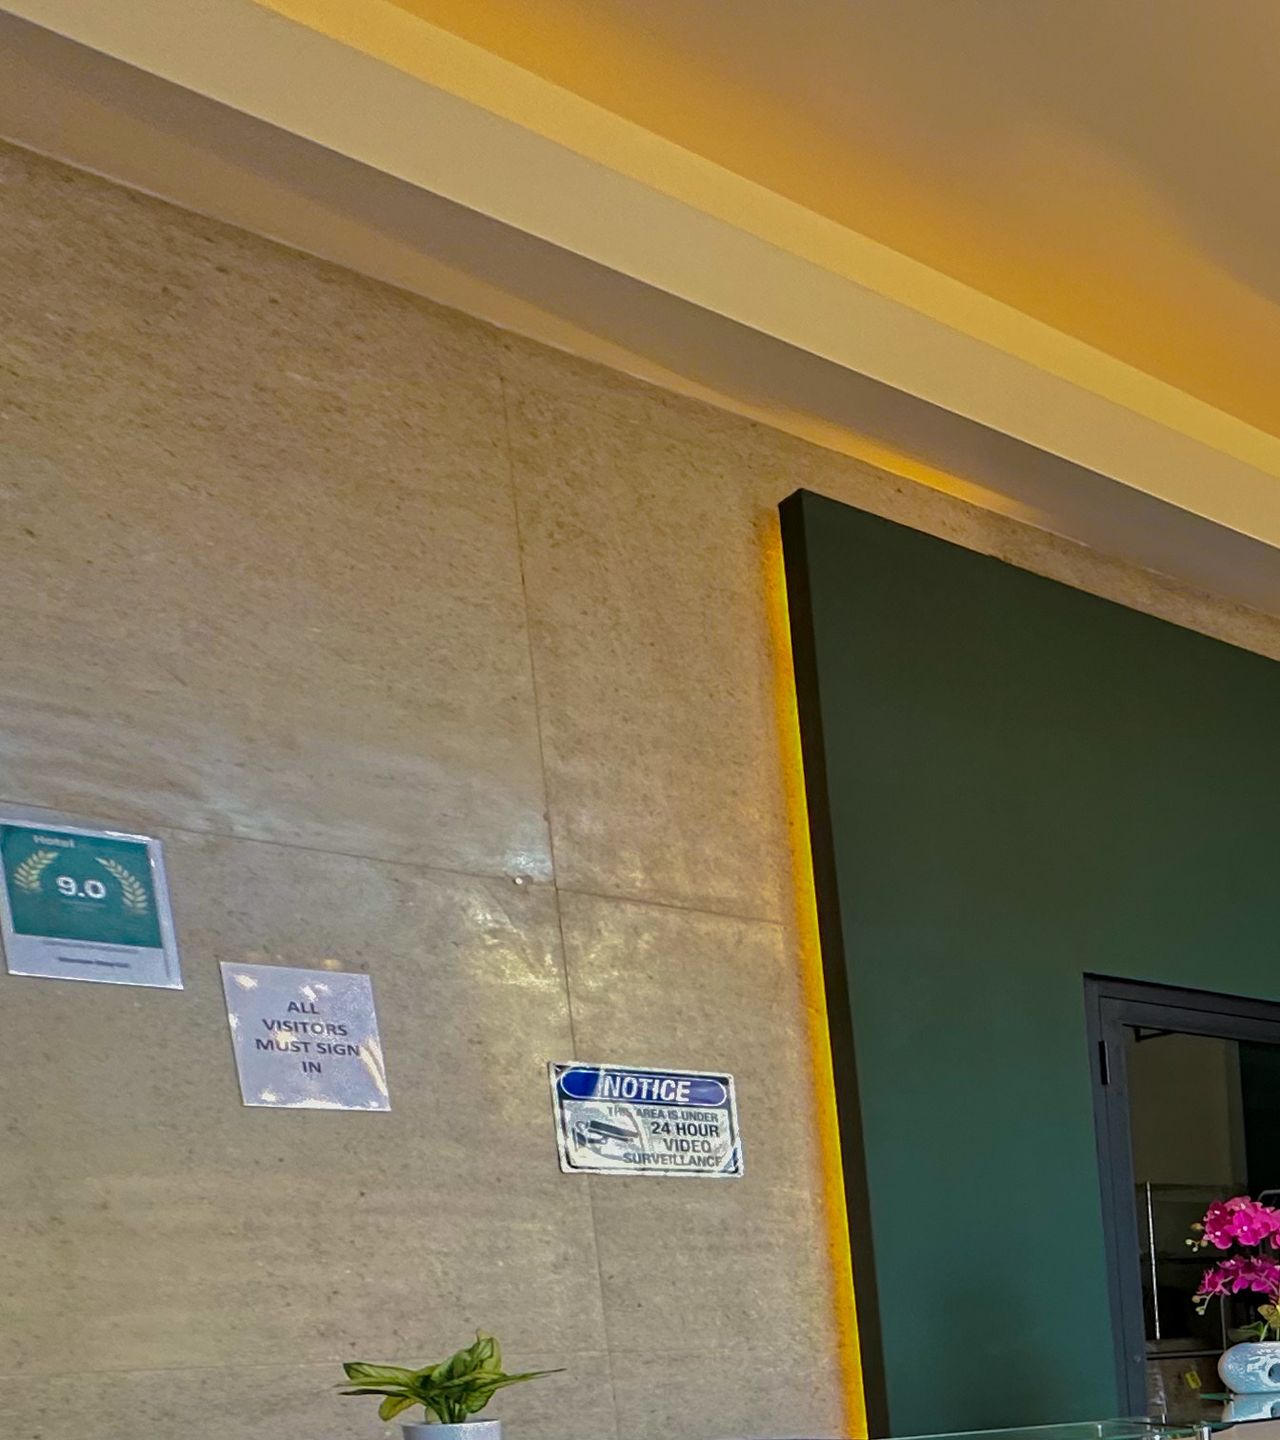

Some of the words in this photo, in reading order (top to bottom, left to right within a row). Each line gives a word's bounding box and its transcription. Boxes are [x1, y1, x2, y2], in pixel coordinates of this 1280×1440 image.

[56, 876, 107, 899] 9.0
[286, 1001, 320, 1015] ALL
[262, 1018, 348, 1036] VISITORS
[255, 1038, 311, 1053] MUST
[317, 1042, 361, 1057] SIGN
[301, 1061, 322, 1074] IN
[603, 1075, 691, 1102] NOTICE
[635, 1108, 665, 1119] AREA
[668, 1110, 679, 1120] IS
[681, 1111, 719, 1123] UNDER
[651, 1121, 671, 1136] 24
[676, 1123, 720, 1138] HOUR
[663, 1138, 712, 1154] VIDEO
[623, 1151, 723, 1168] SURVEILLANCE
